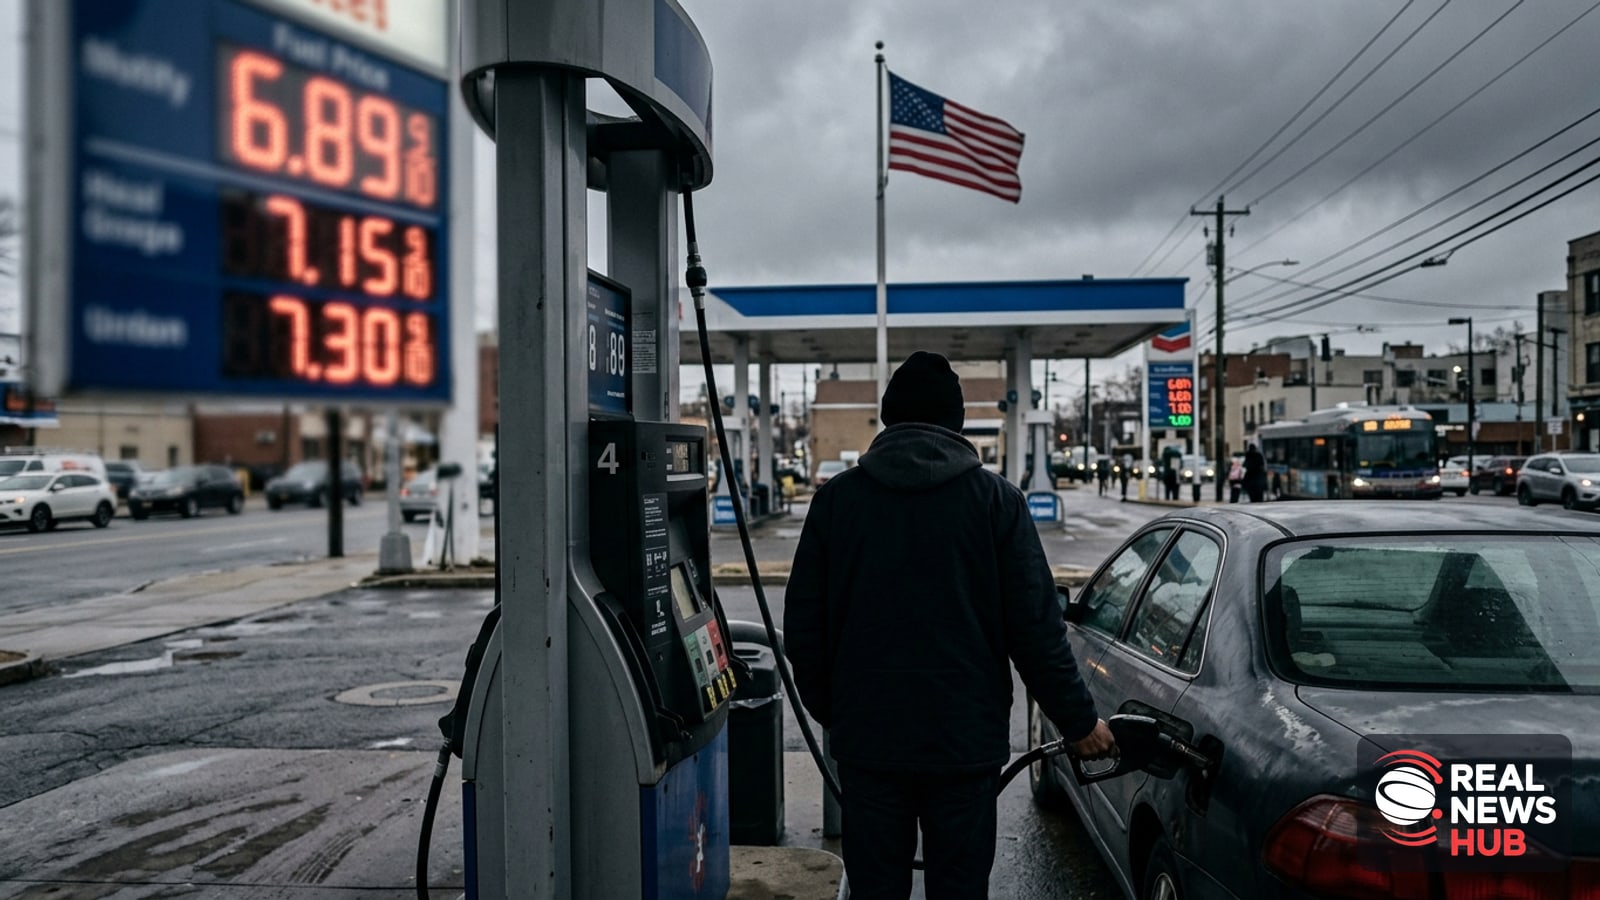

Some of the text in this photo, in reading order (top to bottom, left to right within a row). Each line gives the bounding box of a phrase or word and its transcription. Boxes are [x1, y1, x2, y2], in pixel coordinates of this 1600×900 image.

[230, 48, 401, 200] 6.89
[265, 195, 398, 297] 7.15
[270, 295, 399, 385] 7.30
[597, 442, 620, 475] 4
